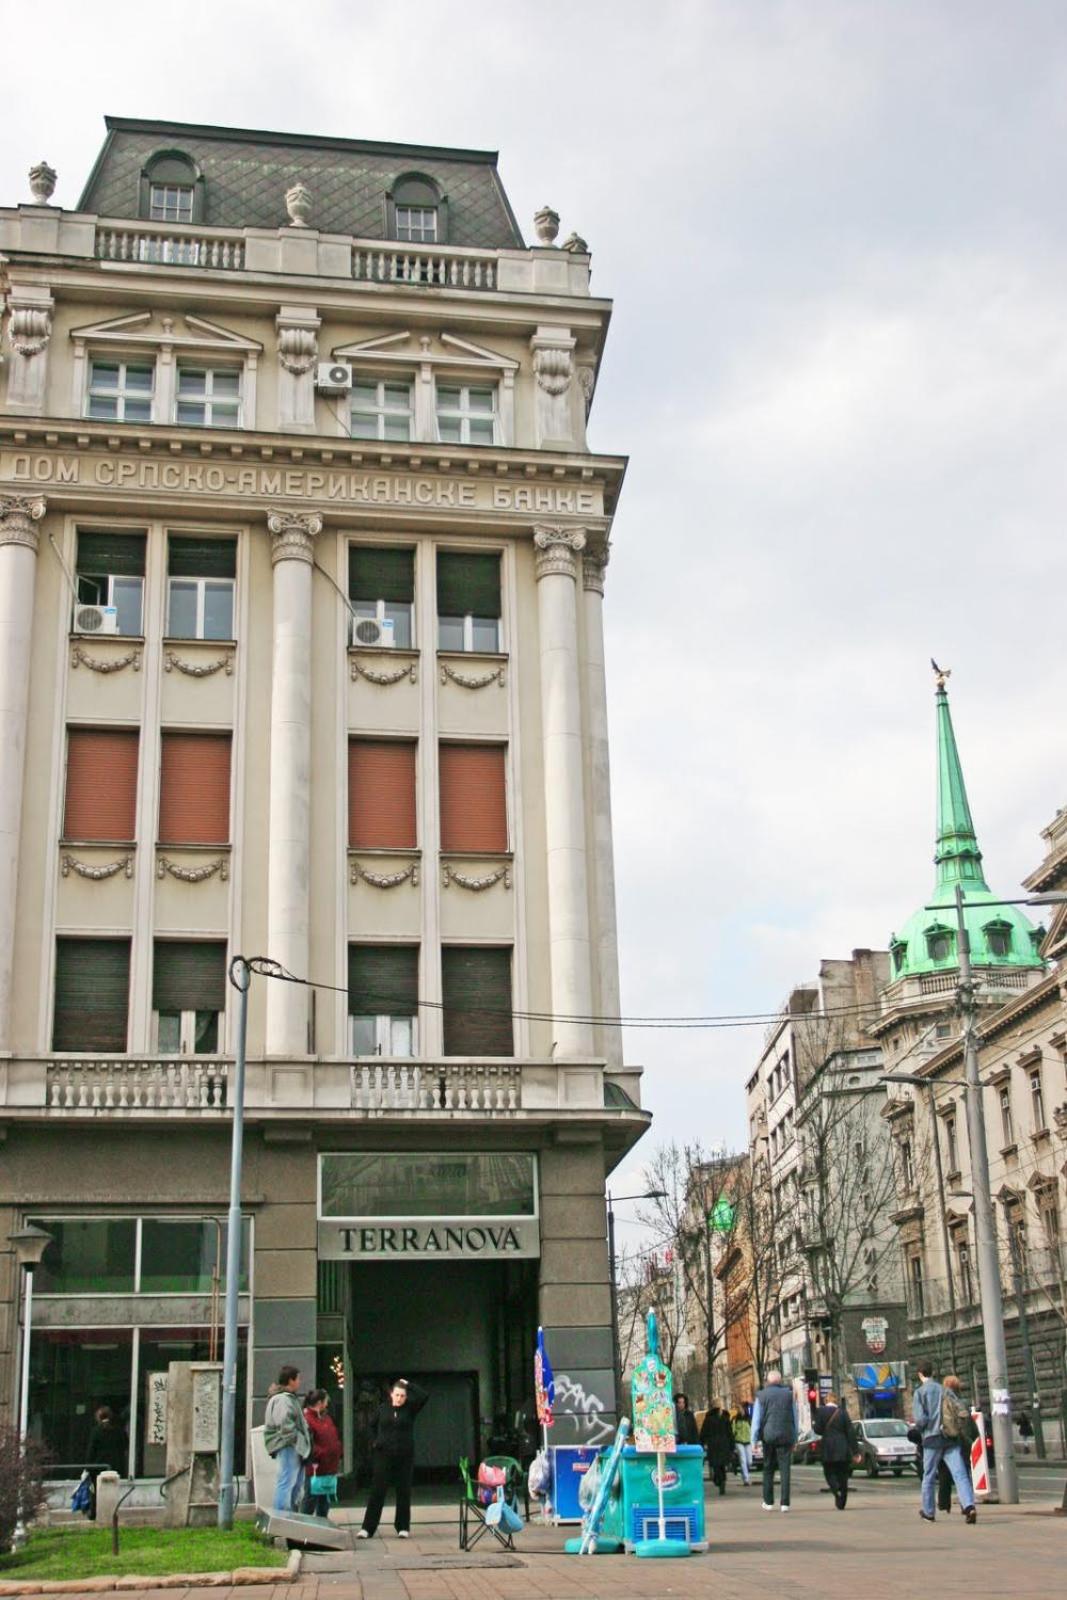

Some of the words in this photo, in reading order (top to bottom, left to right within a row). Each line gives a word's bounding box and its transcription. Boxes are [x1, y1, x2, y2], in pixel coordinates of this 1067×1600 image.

[11, 454, 80, 483] ДОМ
[94, 459, 478, 508] СРПСКО-АМЕРИКАНСКЕ
[492, 484, 594, 515] БАНКЕ
[338, 1226, 521, 1252] TERRANOVA
